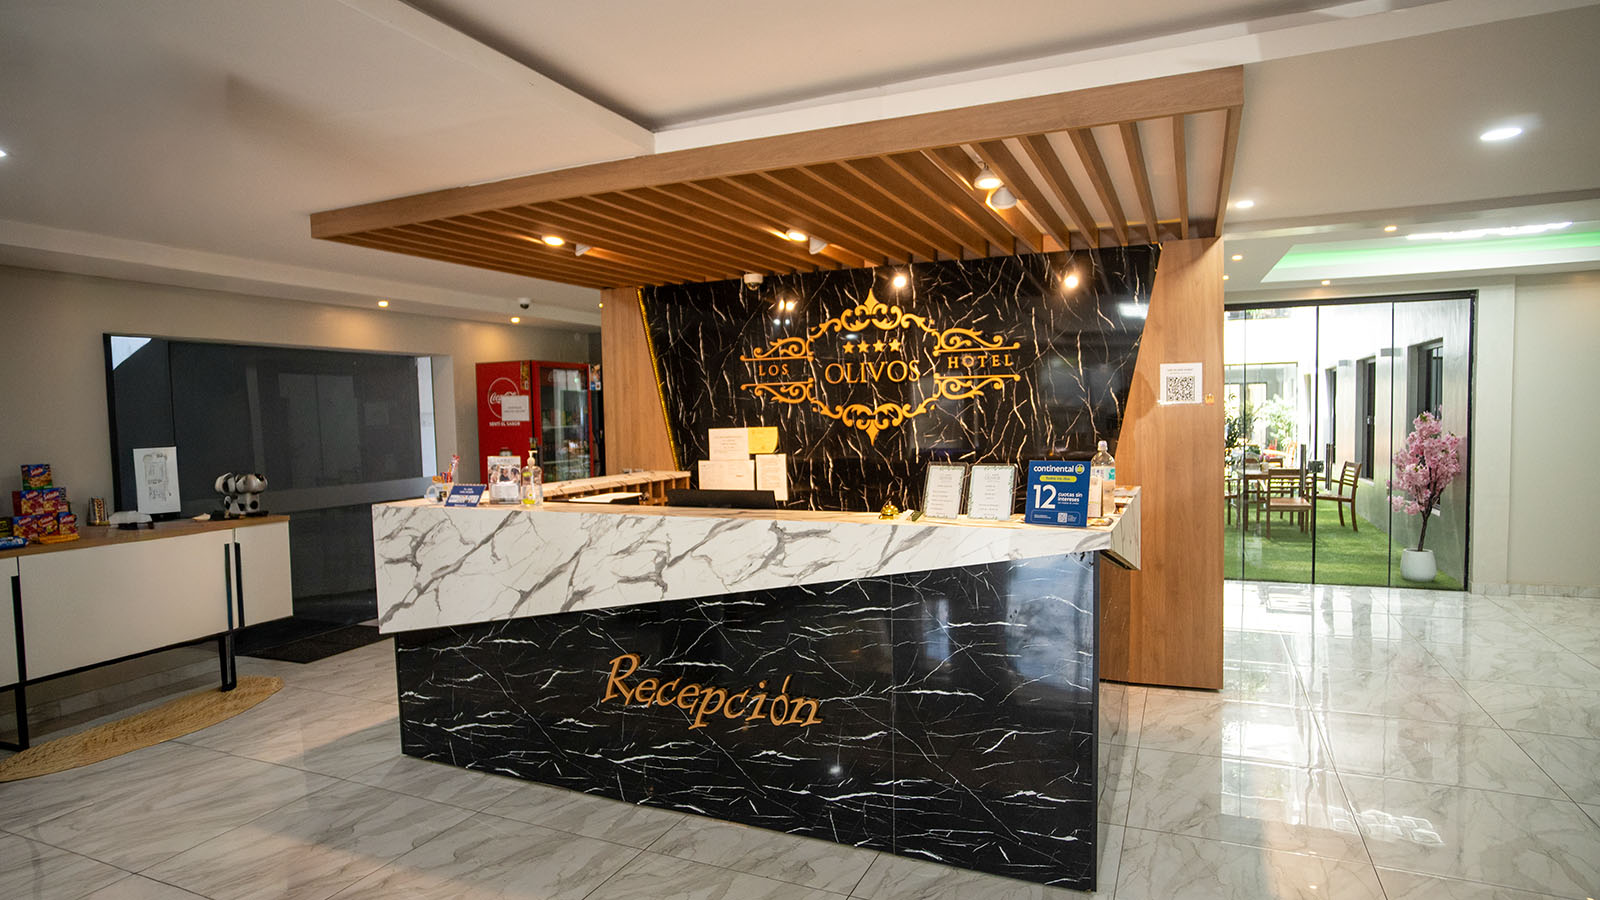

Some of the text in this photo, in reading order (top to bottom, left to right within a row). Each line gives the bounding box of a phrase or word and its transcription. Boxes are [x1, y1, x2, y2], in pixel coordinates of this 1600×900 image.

[758, 354, 1013, 384] LOS OLIVOS HOTEL
[1033, 464, 1074, 473] continental
[1033, 484, 1057, 509] 12
[601, 653, 823, 731] Recepción
